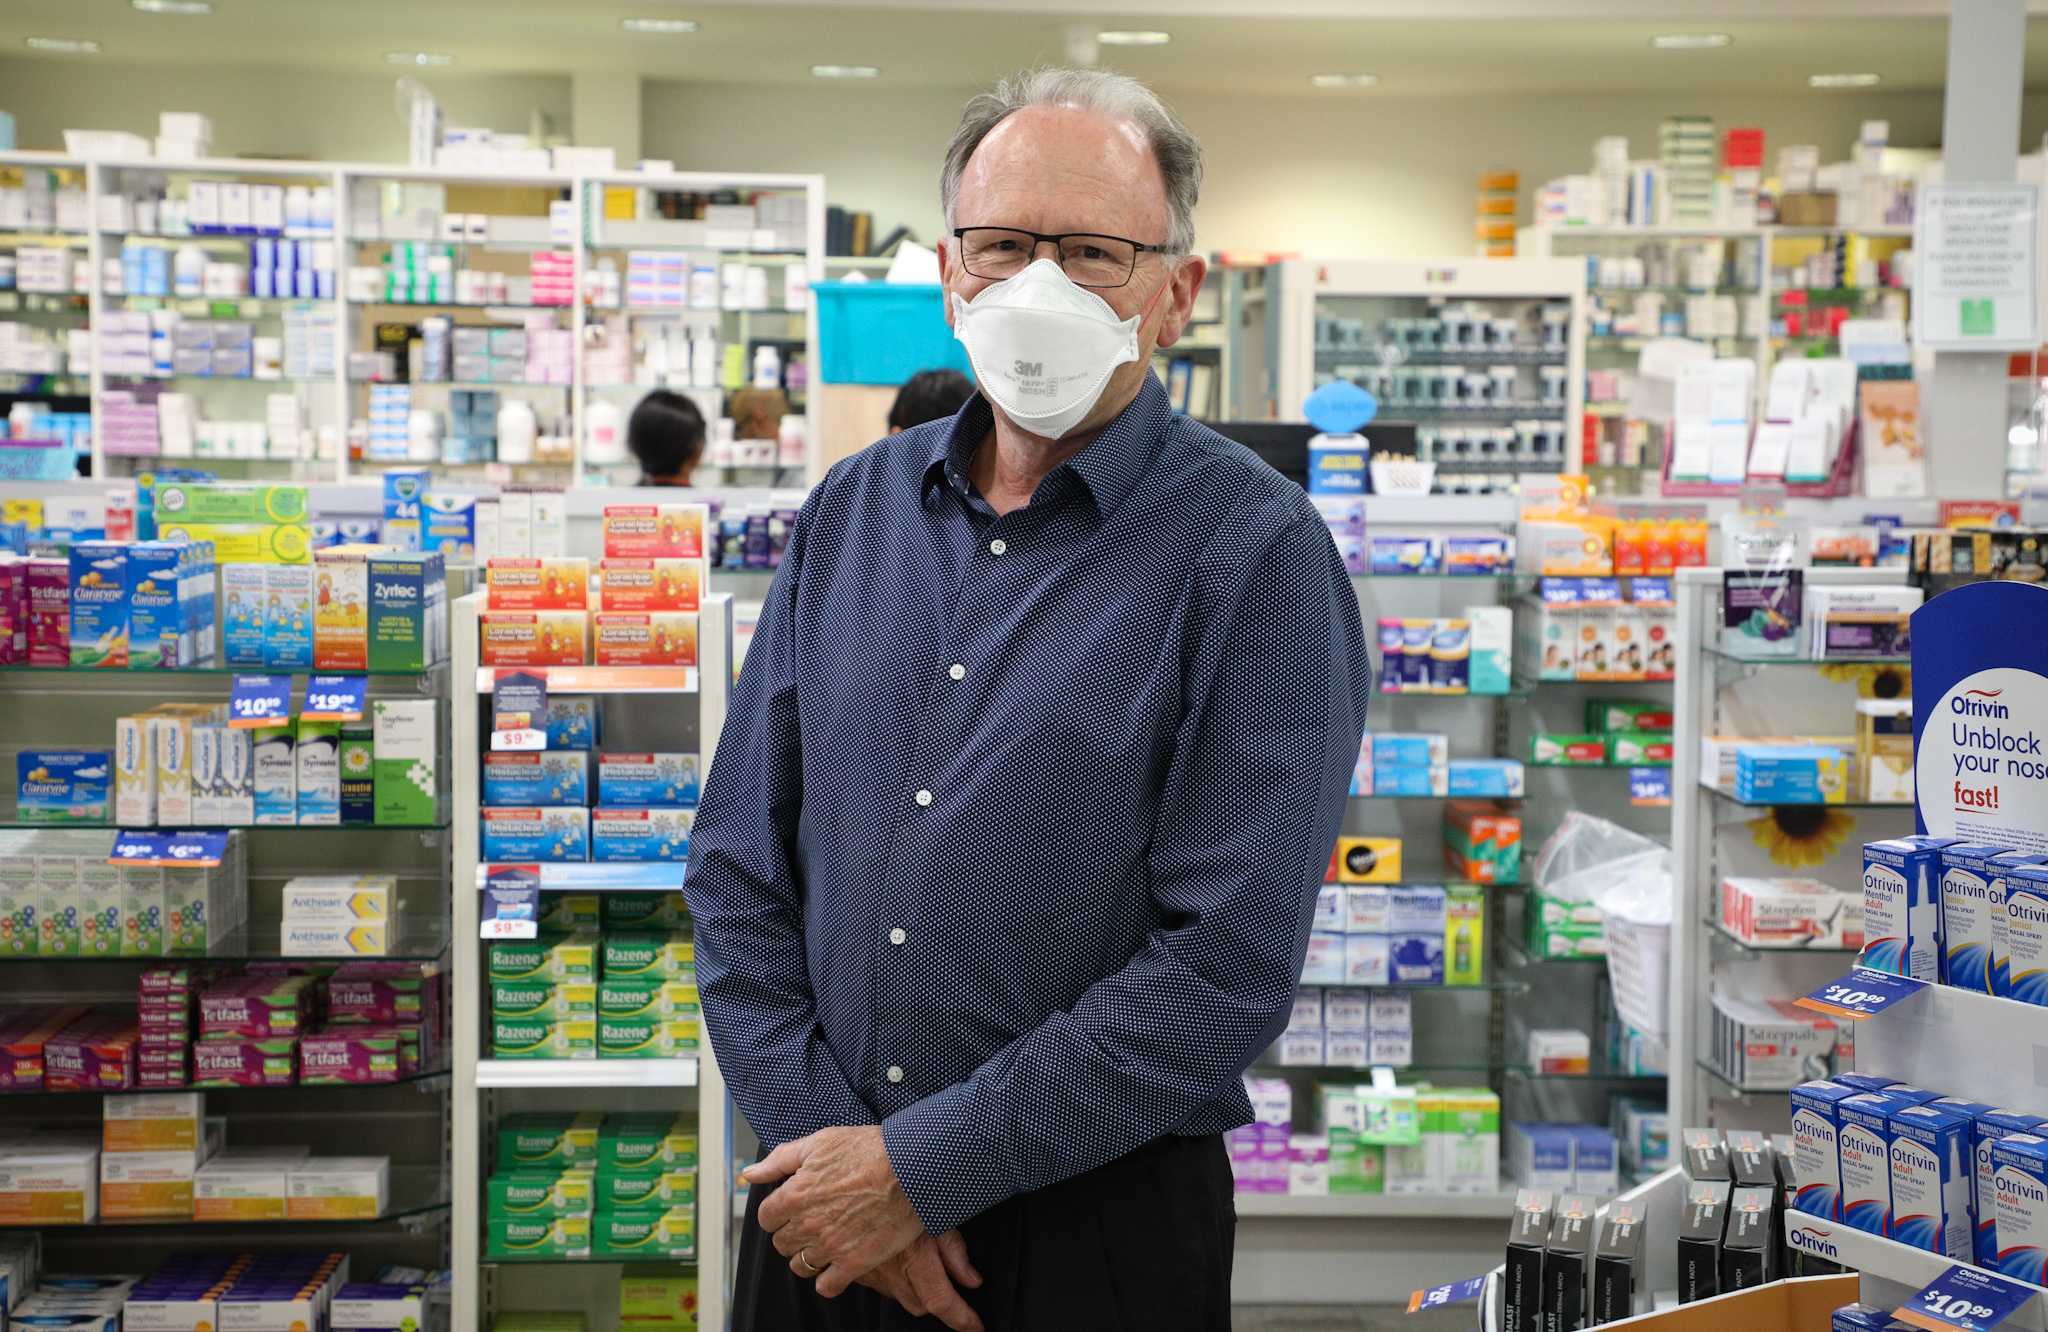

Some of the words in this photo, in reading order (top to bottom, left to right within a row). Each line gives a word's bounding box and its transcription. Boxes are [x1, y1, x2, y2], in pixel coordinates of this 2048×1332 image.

[1014, 360, 1042, 376] 3M
[374, 582, 416, 599] Zyrtec
[1952, 696, 2008, 720] Otrivin
[1953, 723, 2042, 755] Unblock
[1953, 753, 2000, 776] your
[2008, 760, 2048, 780] nos
[1954, 781, 1999, 809] fast!
[1864, 874, 1904, 894] Otrivin
[1944, 880, 1986, 899] Otrivin
[1865, 889, 1892, 903] Menthol
[1866, 900, 1882, 910] Adult
[493, 952, 540, 964] Razene
[606, 948, 652, 962] Razene
[330, 992, 376, 1005] Telfast
[496, 988, 543, 1002] Razene
[602, 990, 648, 1002] Razene
[202, 1008, 250, 1022] Telfast
[497, 1024, 544, 1039] Razene
[602, 1024, 648, 1038] Razene
[46, 1055, 83, 1070] Telfast
[196, 1056, 243, 1069] Telfast
[302, 1052, 350, 1066] Telfast
[1794, 1119, 1833, 1142] Otrivin
[516, 1136, 554, 1147] Razene
[1795, 1134, 1813, 1146] Adult
[1842, 1134, 1884, 1158] Otrivin
[616, 1142, 653, 1154] Razene
[1842, 1149, 1862, 1162] Adult
[1892, 1148, 1936, 1172] Otrivin
[1894, 1162, 1912, 1175] Adult
[614, 1179, 650, 1190] Razene
[1996, 1176, 2044, 1202] Otrivin
[506, 1186, 546, 1198] Razene
[1997, 1192, 2019, 1205] Adult
[506, 1223, 546, 1236] Razene
[612, 1222, 648, 1234] Razene
[1790, 1229, 1838, 1258] Otrivin
[1959, 1269, 1989, 1282] Otrivin
